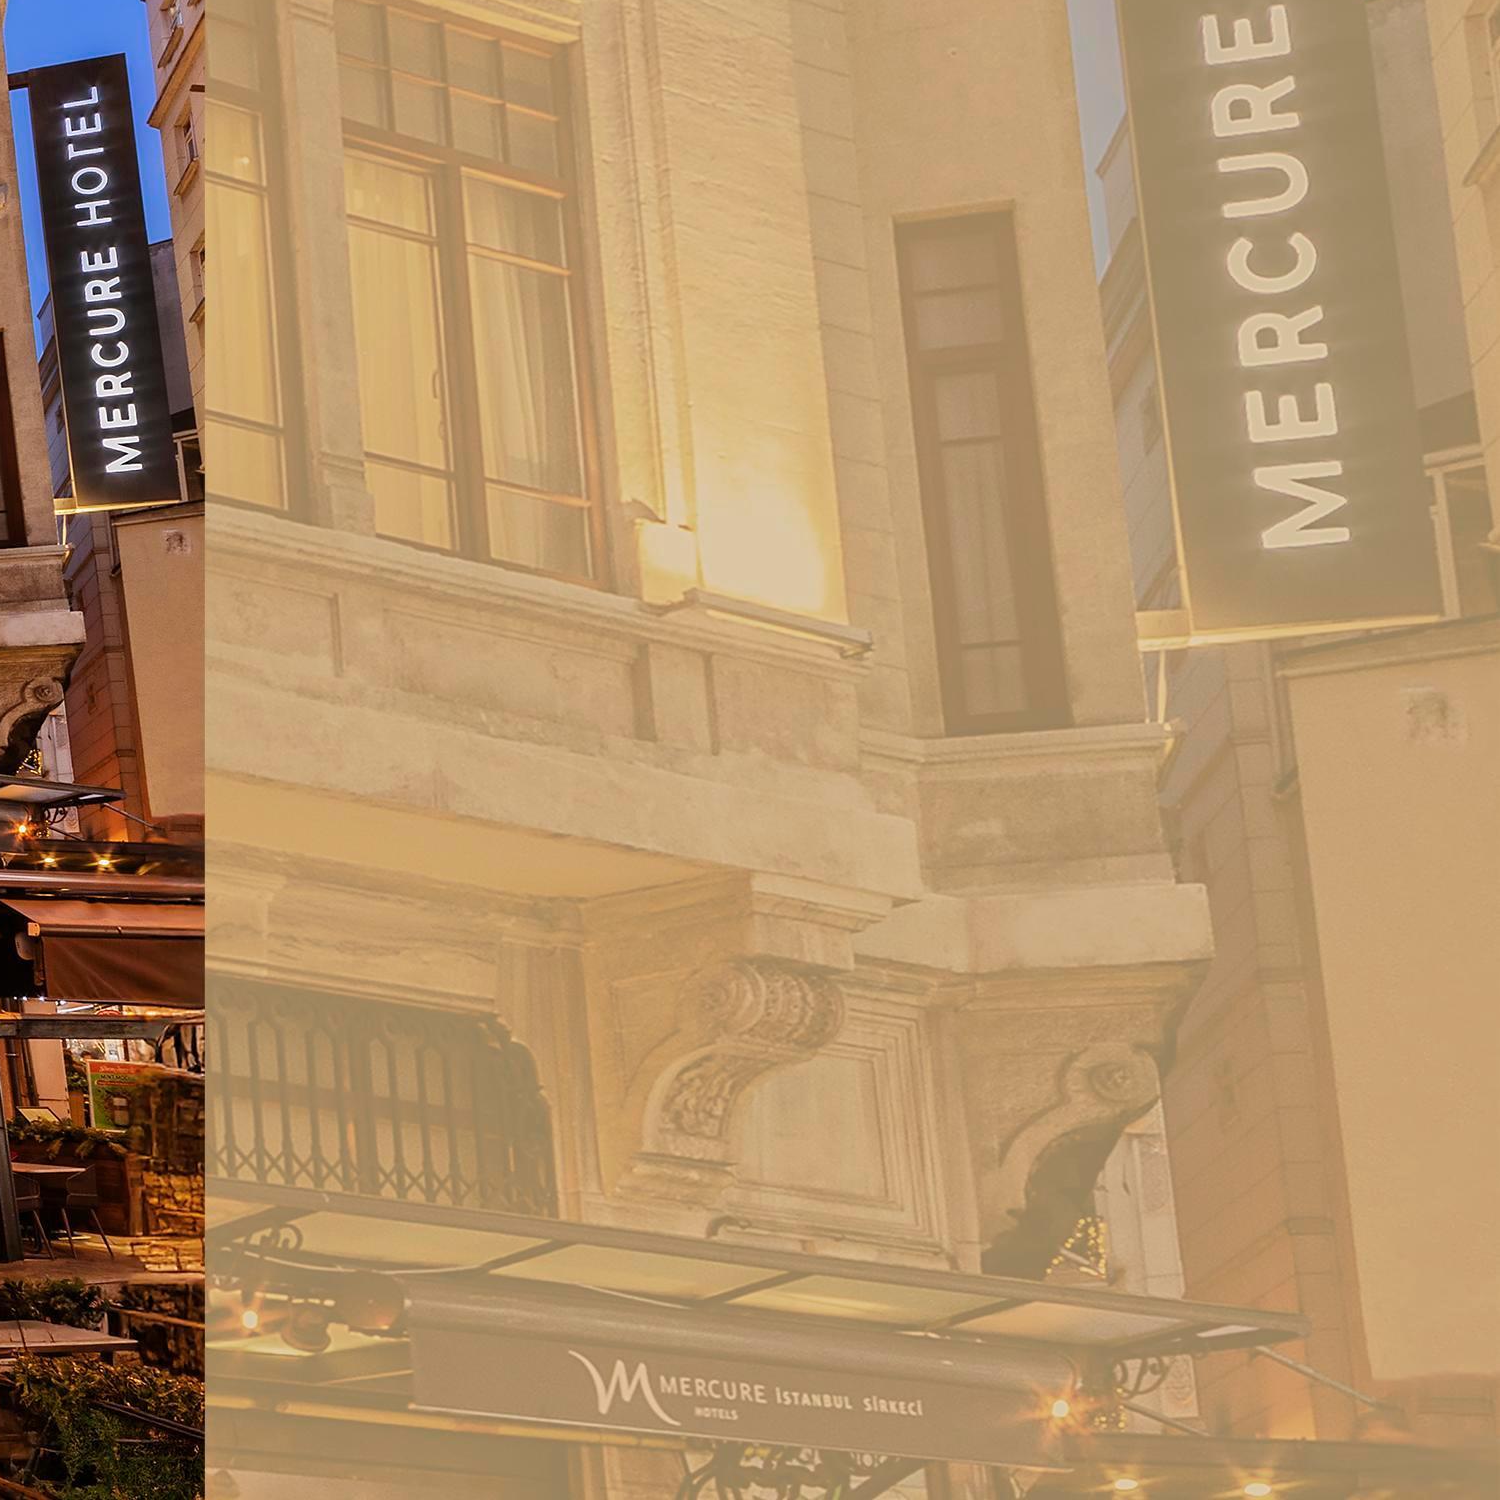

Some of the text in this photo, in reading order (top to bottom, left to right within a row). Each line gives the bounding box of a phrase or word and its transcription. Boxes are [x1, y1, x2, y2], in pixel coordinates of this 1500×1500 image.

[62, 86, 143, 474] MERCURE HOTEL
[1201, 4, 1351, 550] MERCURE
[659, 1375, 923, 1416] MERCURE İSTANBUL SİRKECİ
[695, 1408, 739, 1420] HOTELS
